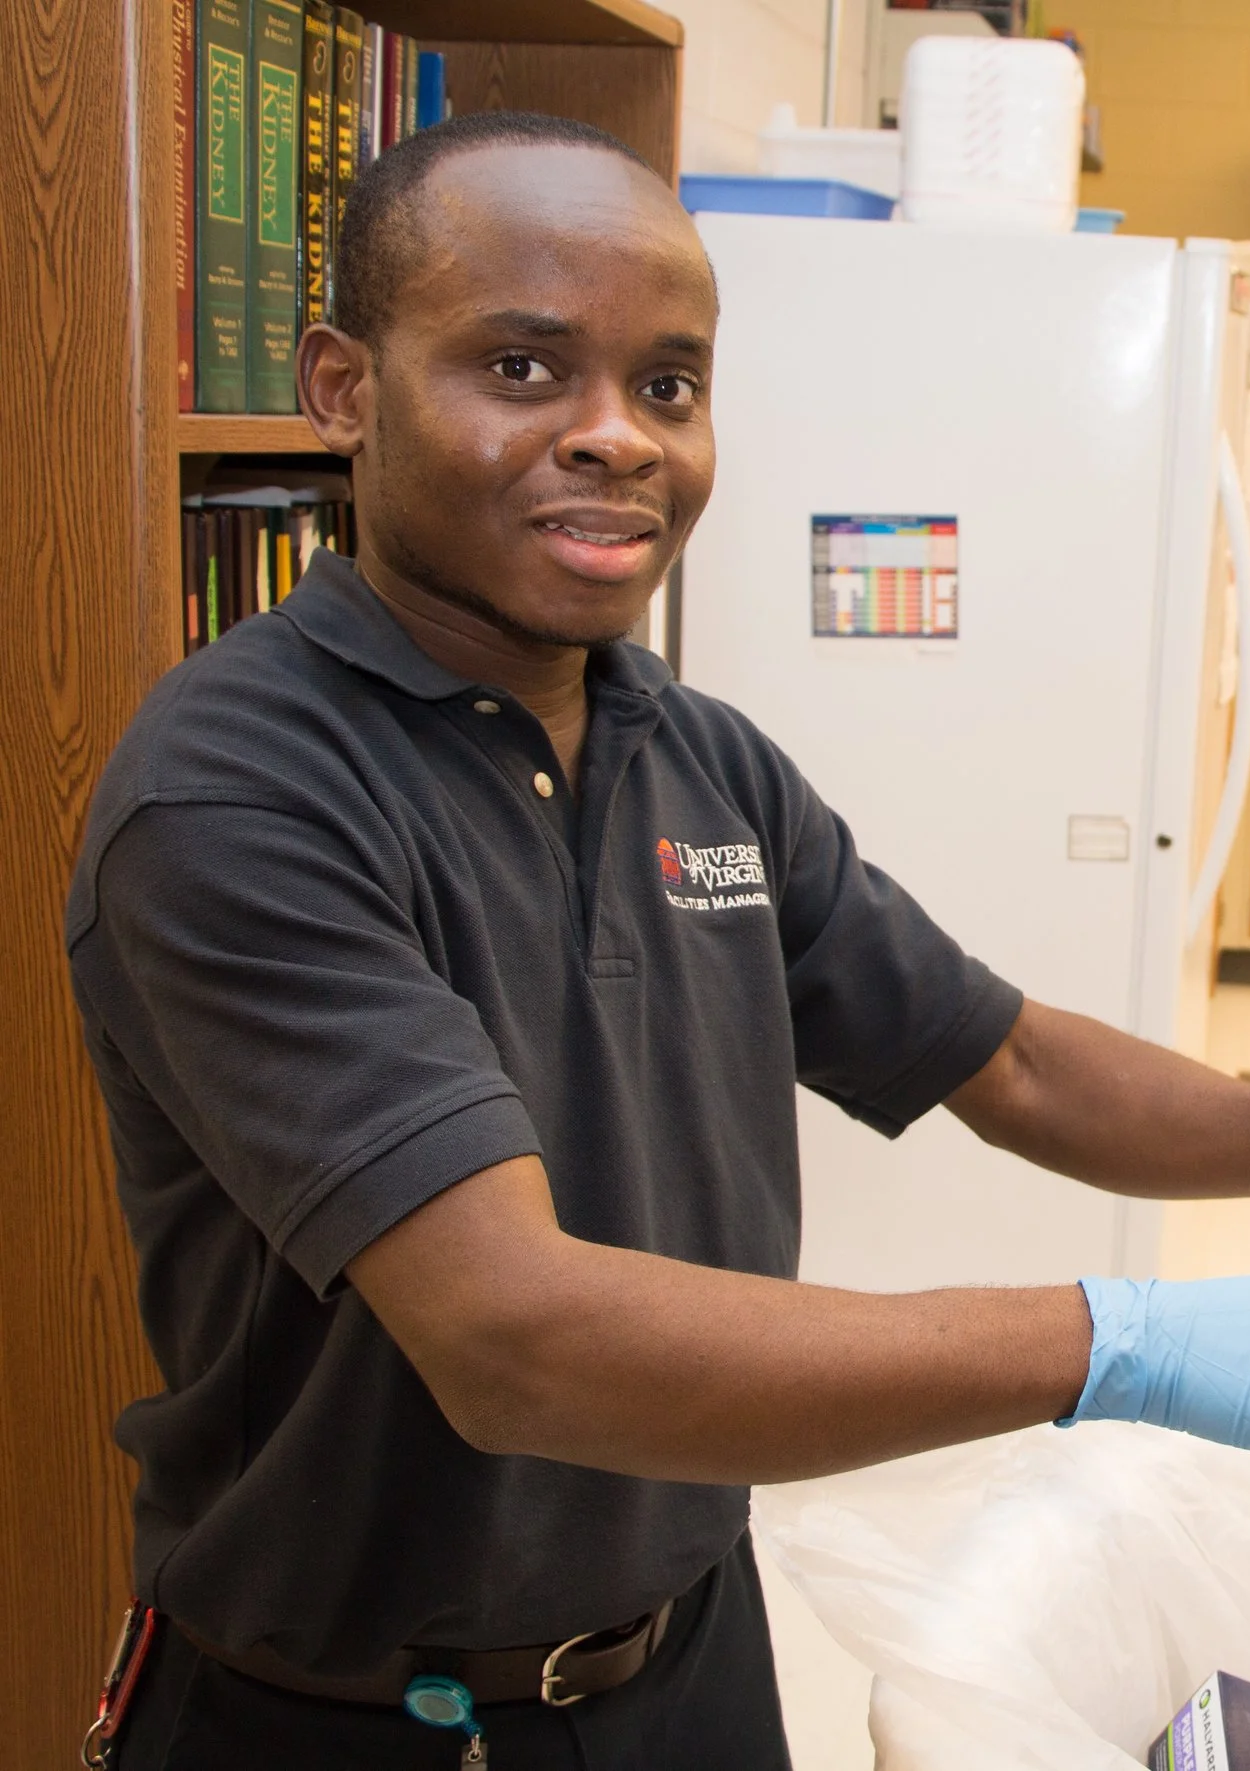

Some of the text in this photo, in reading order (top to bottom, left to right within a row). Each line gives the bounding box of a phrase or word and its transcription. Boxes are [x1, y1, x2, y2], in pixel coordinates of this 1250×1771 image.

[173, 0, 188, 290] Physical Examination
[211, 55, 229, 209] KIDNEY
[228, 62, 241, 122] THE
[279, 83, 294, 143] THE
[338, 98, 353, 182] THE
[262, 77, 282, 231] KIDNEY
[308, 90, 323, 323] THE KIDNE
[699, 864, 767, 891] VIRGIN
